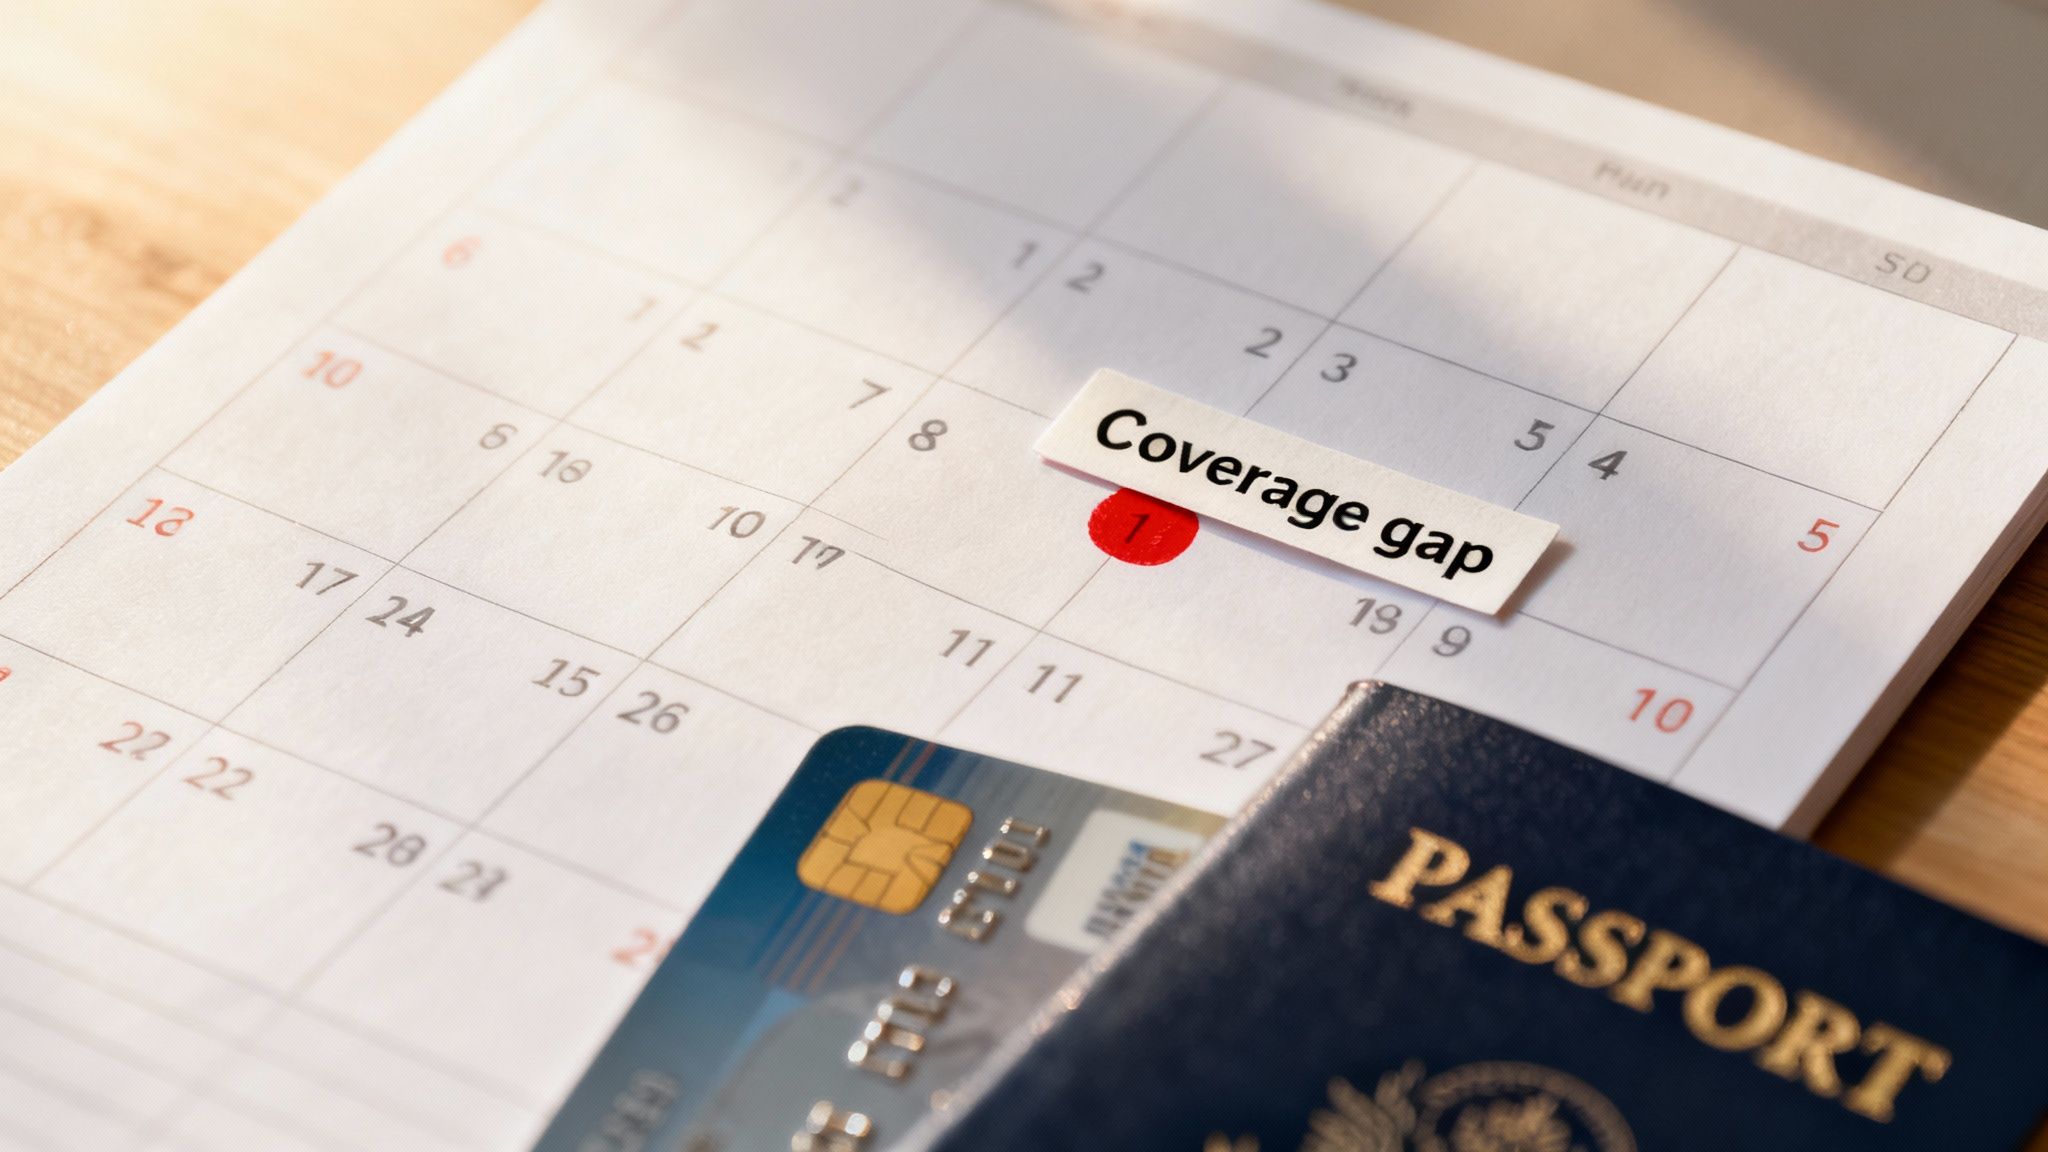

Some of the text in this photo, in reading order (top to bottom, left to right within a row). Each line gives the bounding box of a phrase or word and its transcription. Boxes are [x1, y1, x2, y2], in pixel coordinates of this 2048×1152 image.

[1066, 260, 1106, 295] 2
[1243, 326, 1284, 360] 2
[301, 349, 364, 390] 10
[1320, 352, 1359, 384] 3
[849, 378, 892, 410] 7
[908, 418, 949, 453] 8
[1513, 418, 1556, 453] 5
[1587, 449, 1628, 482] 4
[1096, 408, 1494, 580] Coverage gap
[709, 505, 767, 540] 10
[1124, 512, 1151, 545] 1
[1796, 518, 1841, 554] 5
[296, 560, 360, 597] 17
[365, 594, 437, 640] 24
[940, 628, 996, 669] 11
[1432, 624, 1473, 659] 9
[531, 657, 602, 699] 15
[1027, 663, 1084, 706] 11
[616, 689, 691, 735] 26
[1627, 686, 1696, 735] 10
[1198, 729, 1276, 774] 27
[183, 755, 256, 802] 22
[1367, 827, 1952, 1125] PASSPORT
